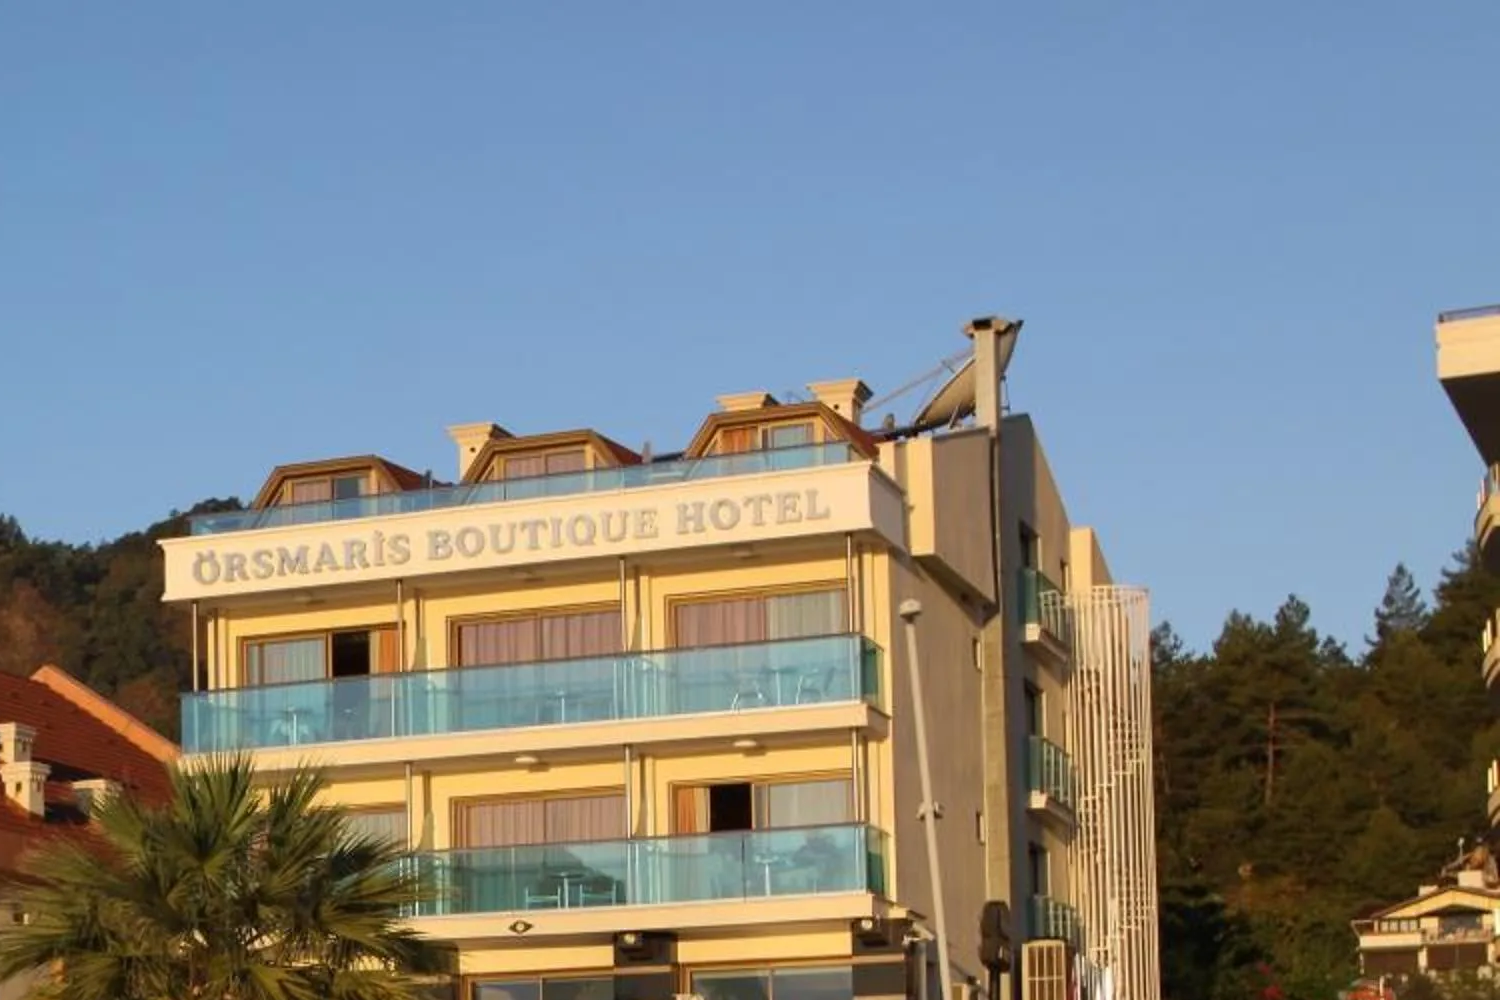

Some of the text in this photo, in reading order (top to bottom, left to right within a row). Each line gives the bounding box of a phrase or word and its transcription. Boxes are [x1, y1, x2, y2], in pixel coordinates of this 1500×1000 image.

[192, 489, 831, 585] ÖRSMARİS BOUTIQUE HOTEL
